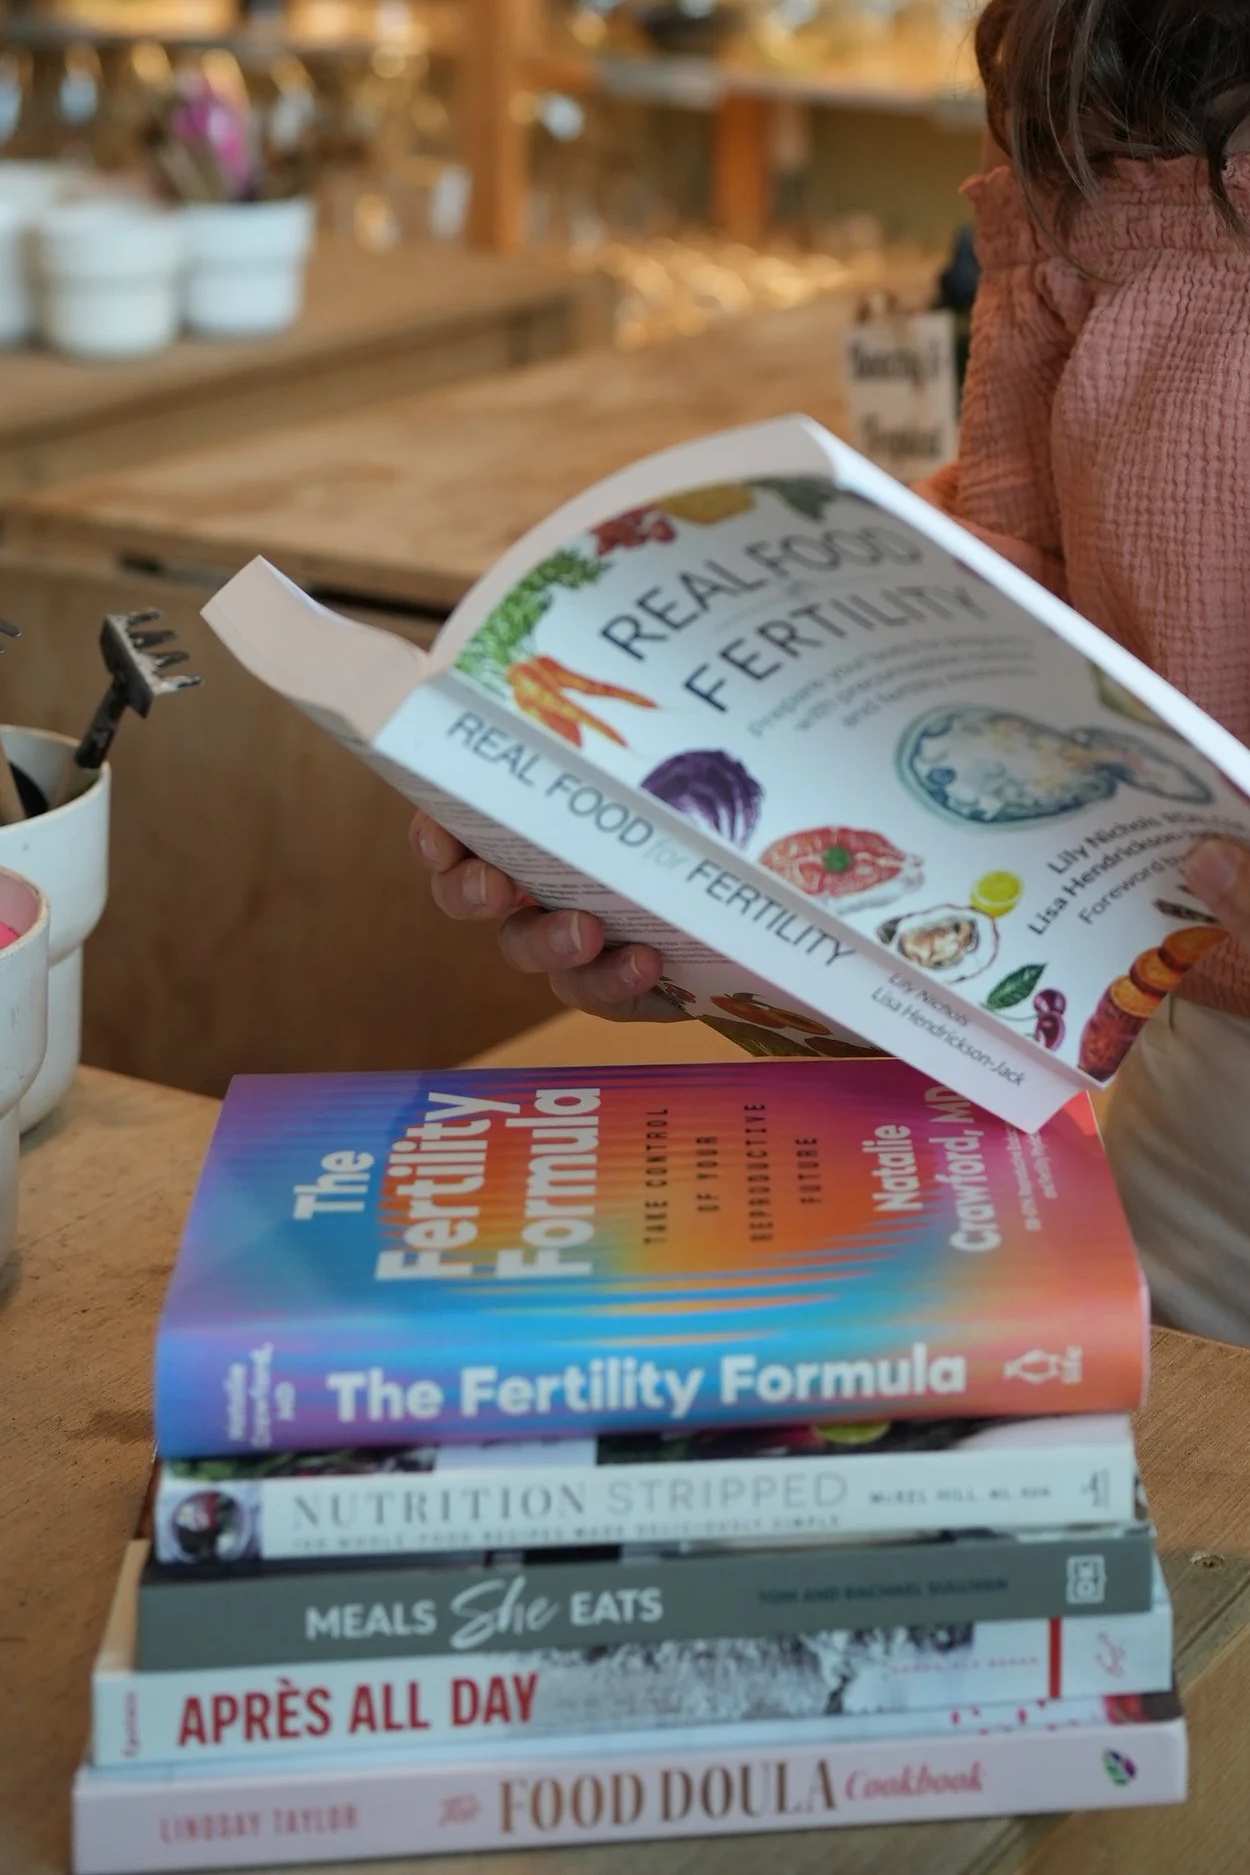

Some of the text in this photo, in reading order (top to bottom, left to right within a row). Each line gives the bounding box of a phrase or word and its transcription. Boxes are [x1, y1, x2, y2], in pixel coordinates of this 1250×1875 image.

[599, 526, 925, 663] REAL FOOD
[683, 585, 988, 713] FERTILITY
[446, 711, 540, 788] REAL
[545, 771, 656, 851] FOOD
[685, 856, 857, 968] FERTILITY
[1027, 896, 1069, 937] Lisa
[1078, 855, 1166, 926] Foreword
[871, 985, 1026, 1087] Lisa Hendrickson-Jack
[294, 1150, 375, 1220] The
[375, 1091, 521, 1281] Fertility
[493, 1088, 602, 1280] Formula
[644, 1108, 669, 1244] TAKE CONTROL
[695, 1136, 721, 1211] OF YOUR
[744, 1104, 774, 1242] REPRODUCTIVE
[795, 1138, 823, 1204] FUTURE
[861, 1124, 924, 1212] Natalie
[924, 1085, 1003, 1252] Crawford, MD
[326, 1343, 967, 1424] The Fertility Formula
[292, 1480, 587, 1534] NUTRITION
[604, 1471, 849, 1518] STRIPPED
[305, 1600, 437, 1641] MEALS
[450, 1575, 561, 1651] She
[570, 1588, 664, 1626] EATS
[177, 1677, 332, 1747] APRÈS
[349, 1681, 430, 1734] ALL
[451, 1672, 540, 1727] DAY
[159, 1810, 263, 1846] LINDSAY
[272, 1802, 360, 1836] TAYLOR
[499, 1772, 646, 1834] FOOD
[659, 1758, 839, 1823] DOULA
[843, 1761, 986, 1802] Cookbook
